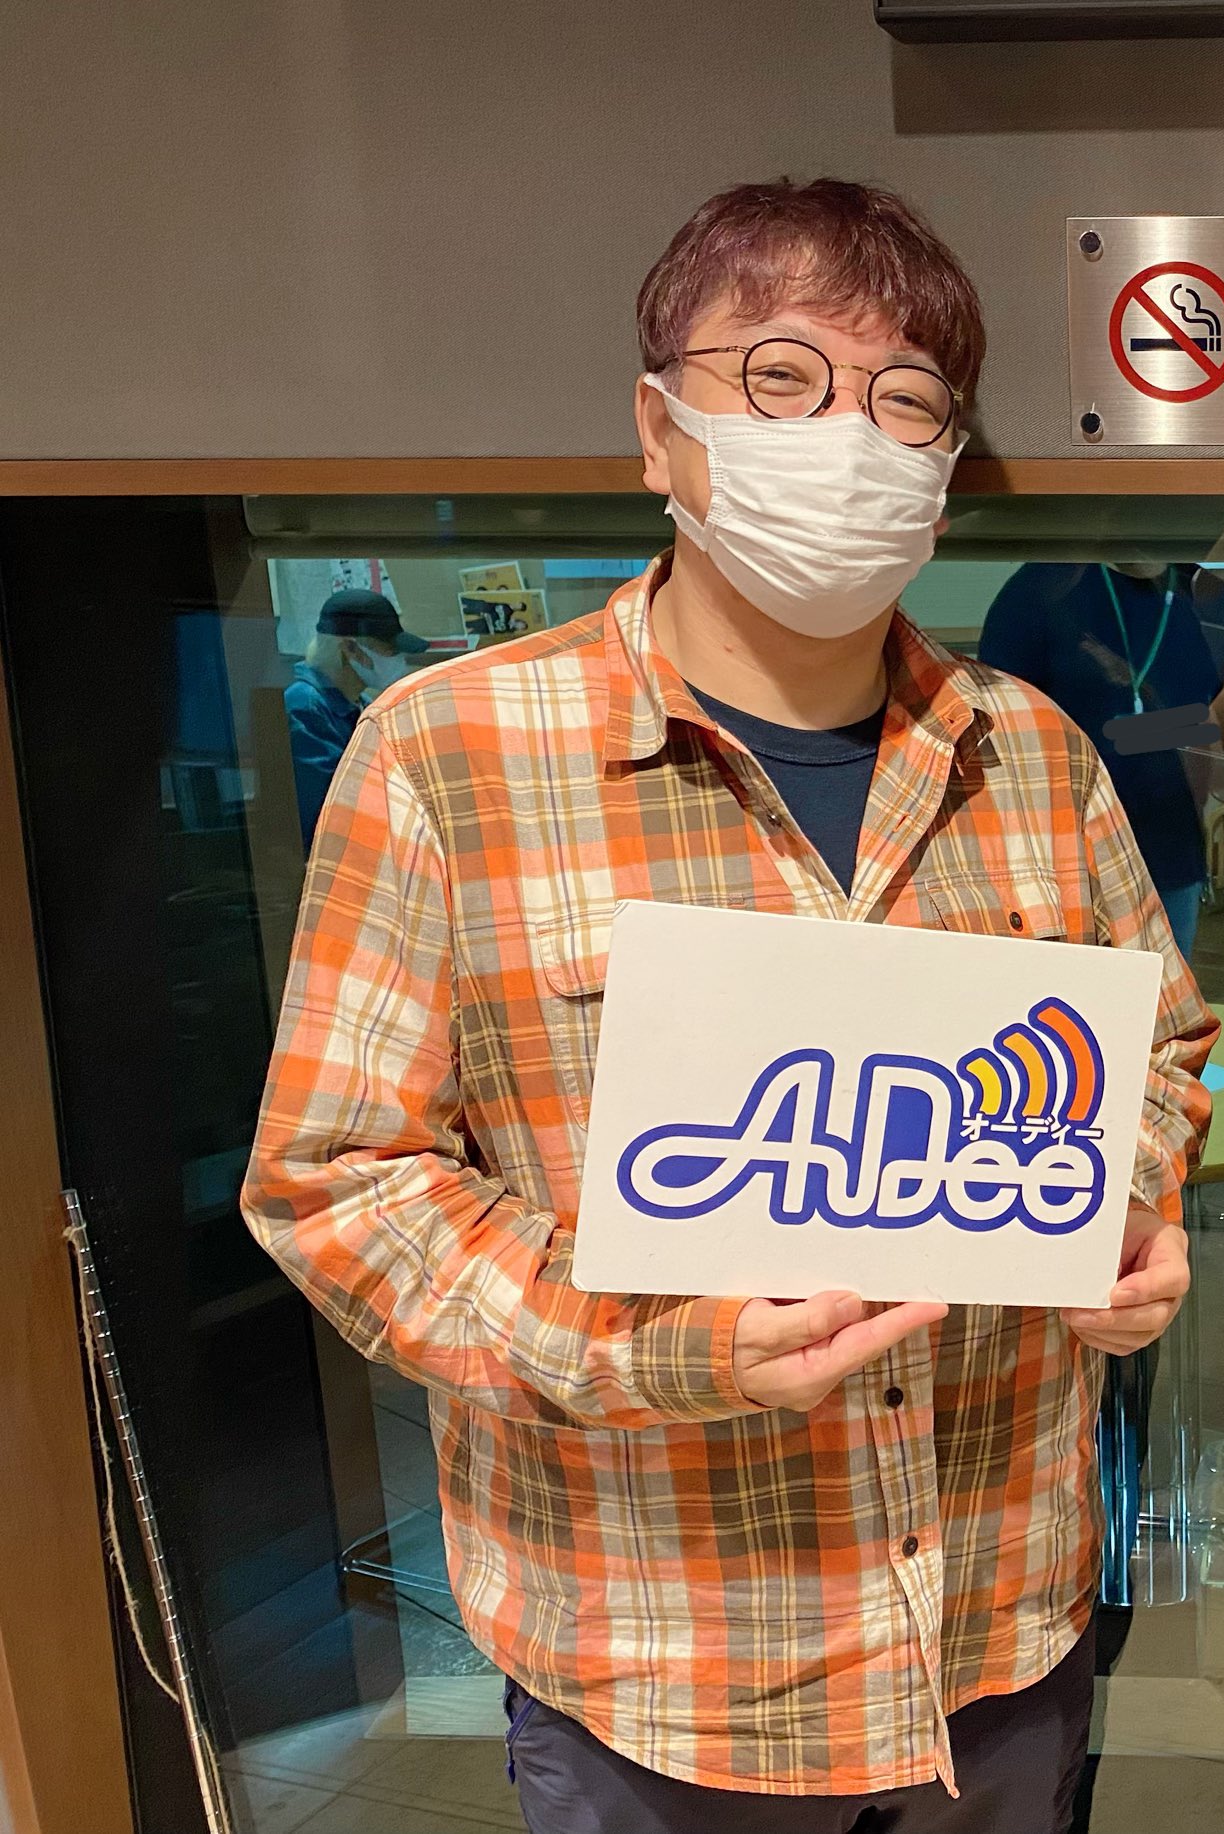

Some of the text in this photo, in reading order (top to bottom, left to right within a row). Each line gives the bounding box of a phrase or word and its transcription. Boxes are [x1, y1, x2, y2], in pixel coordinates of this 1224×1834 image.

[959, 1112, 1104, 1147] オーディー
